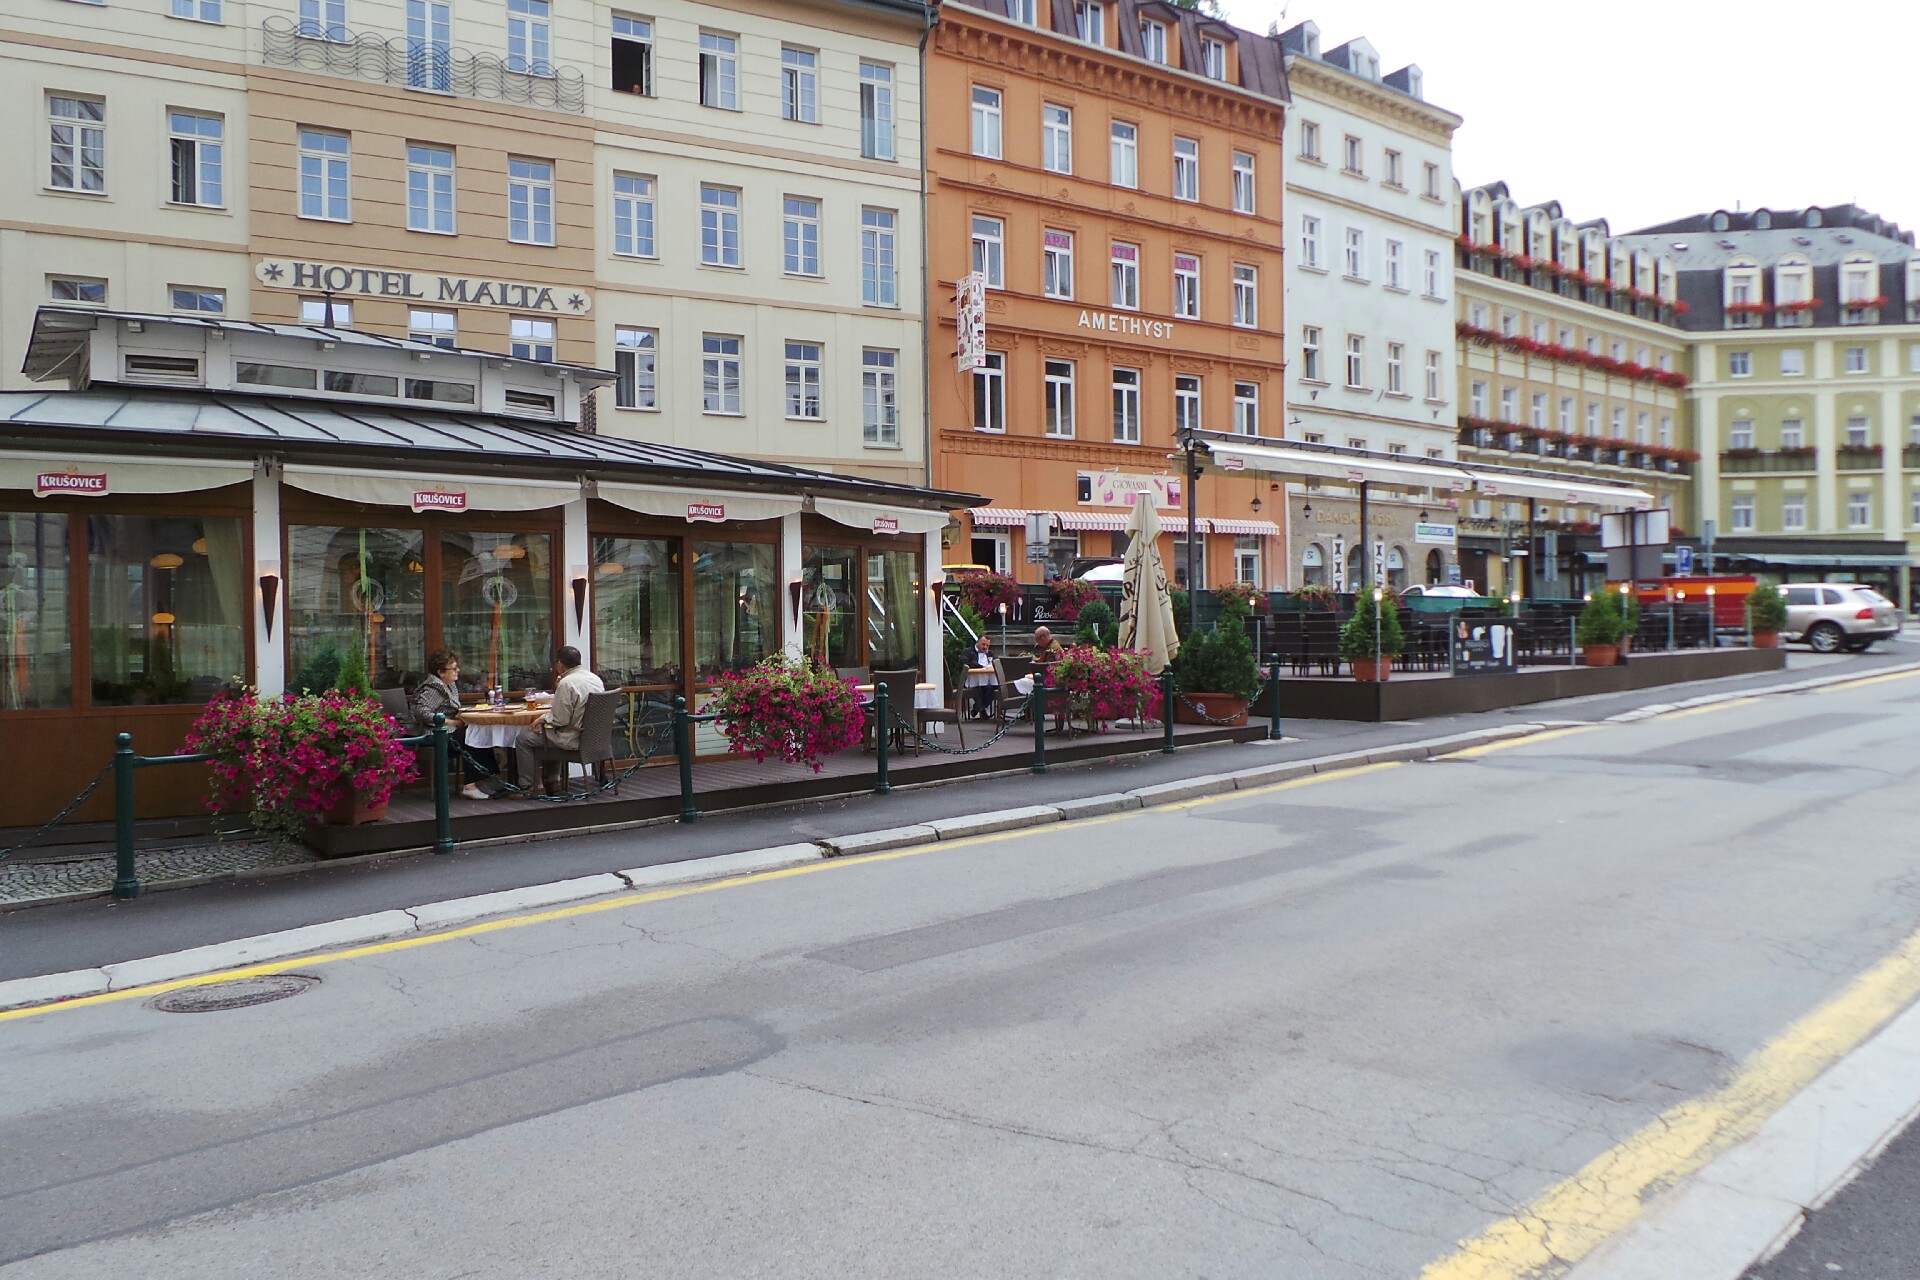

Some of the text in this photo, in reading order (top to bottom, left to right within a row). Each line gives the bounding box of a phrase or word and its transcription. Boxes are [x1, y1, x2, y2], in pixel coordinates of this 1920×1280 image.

[292, 263, 558, 311] HOTEL MALTA
[1078, 311, 1173, 338] AMETHYST
[41, 475, 102, 488] KRUŠOVICE
[1112, 479, 1148, 490] GIOVANNI
[416, 493, 463, 505] KRUŠOVICE
